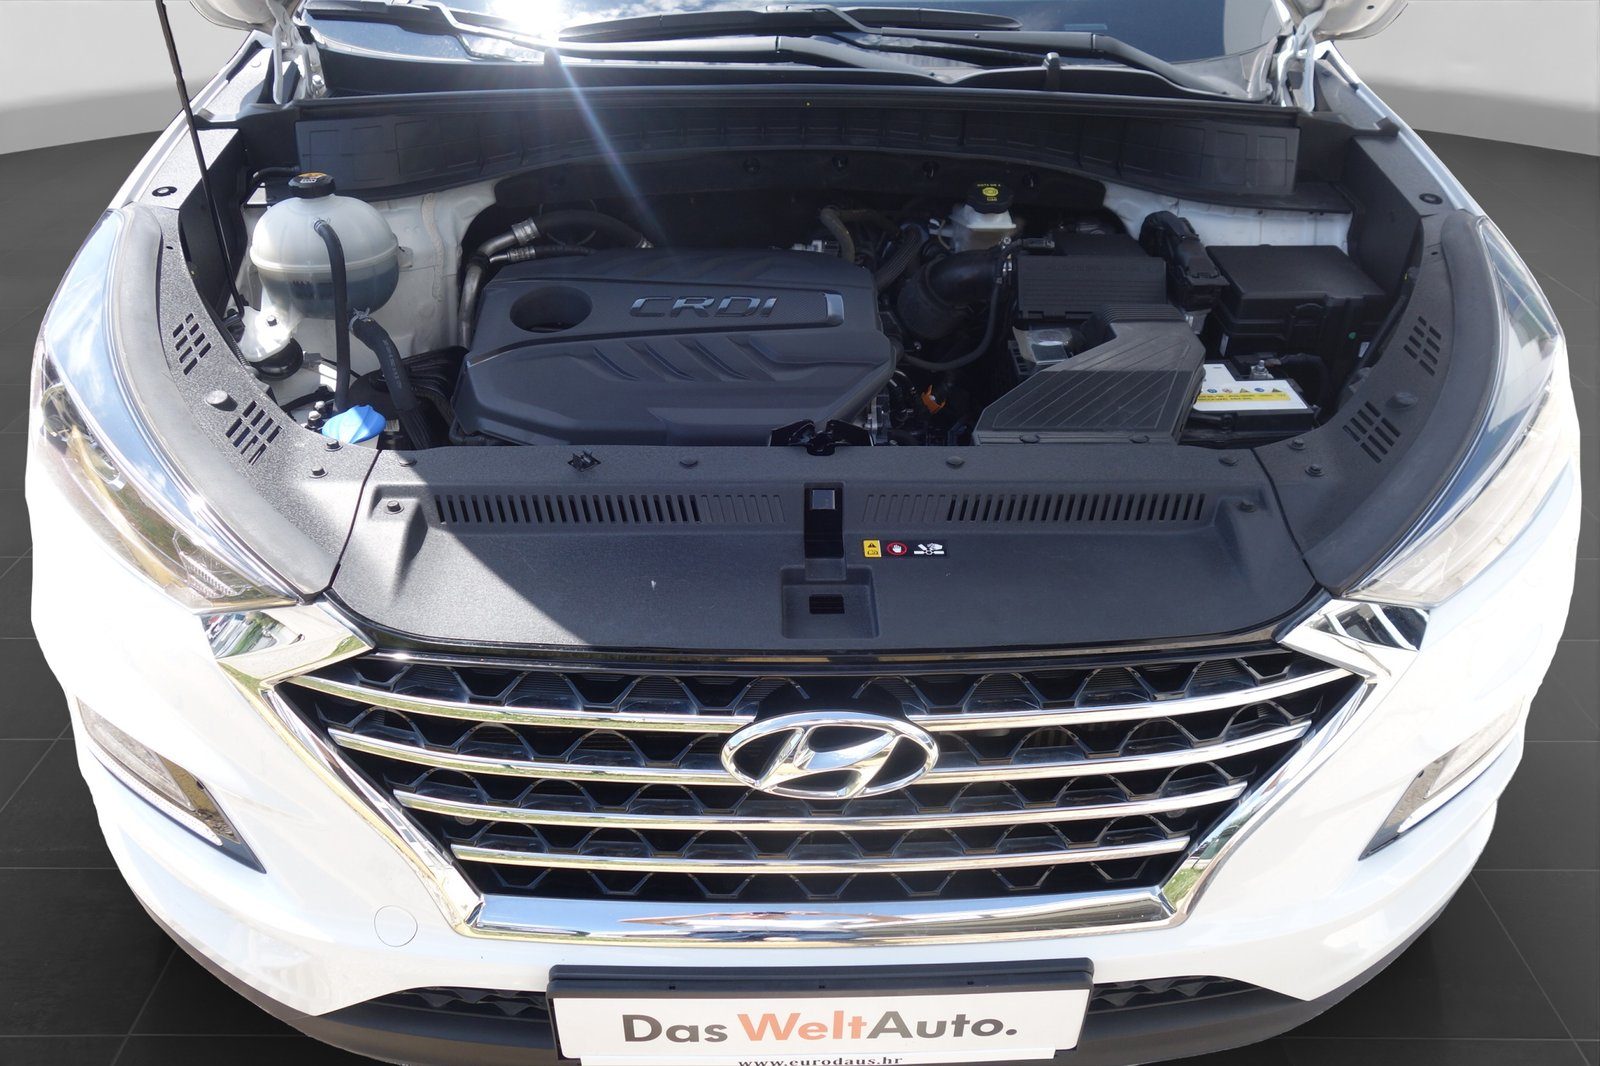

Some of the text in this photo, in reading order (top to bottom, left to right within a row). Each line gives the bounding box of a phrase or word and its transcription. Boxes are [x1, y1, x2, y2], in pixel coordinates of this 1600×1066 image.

[630, 296, 777, 318] CRDI
[621, 1014, 728, 1043] Das
[738, 1056, 903, 1066] www.eurodaus.hr
